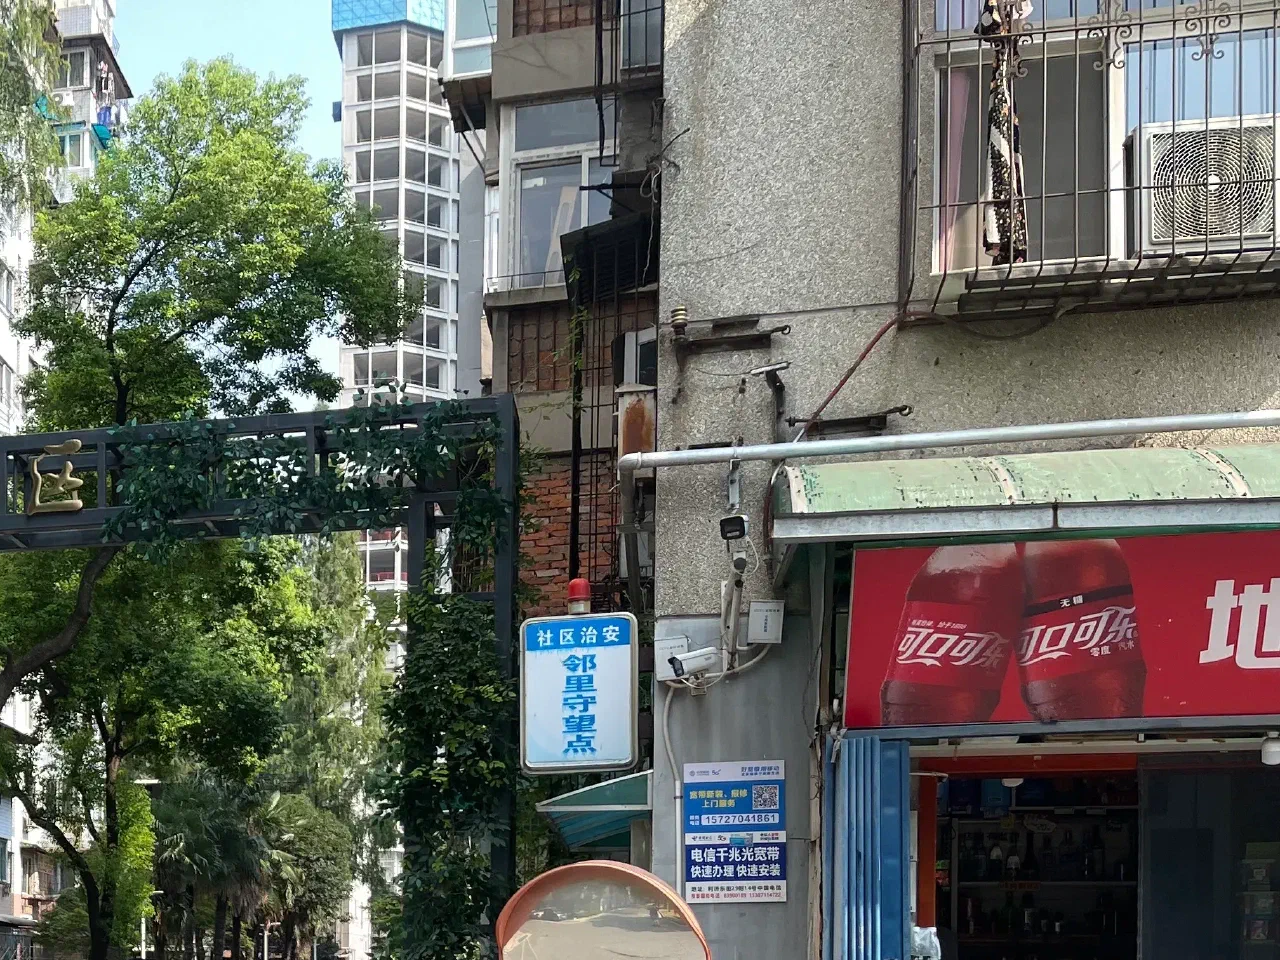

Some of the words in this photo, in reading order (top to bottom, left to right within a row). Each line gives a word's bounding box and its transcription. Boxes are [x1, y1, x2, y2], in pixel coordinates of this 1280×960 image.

[1060, 595, 1083, 608] 无糖
[1198, 576, 1280, 669] 地
[536, 624, 621, 647] 社区治安
[1017, 606, 1138, 667] 可口可乐
[896, 626, 1011, 668] 可口可乐
[1090, 645, 1111, 657] 零度
[561, 653, 597, 755] 邻里守望点
[705, 814, 776, 824] 15727041861
[690, 846, 780, 863] 电信千兆光宽带
[690, 864, 735, 879] 快速办理
[736, 863, 781, 877] 快速安装
